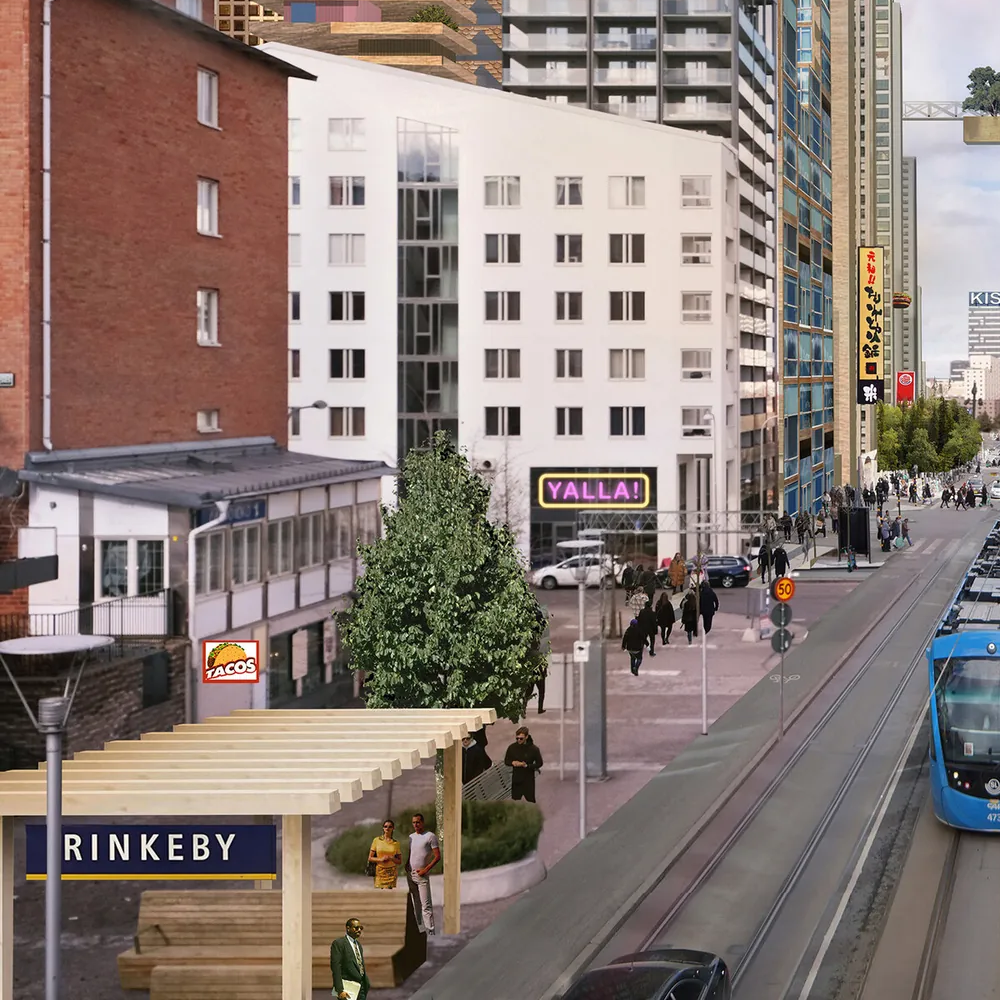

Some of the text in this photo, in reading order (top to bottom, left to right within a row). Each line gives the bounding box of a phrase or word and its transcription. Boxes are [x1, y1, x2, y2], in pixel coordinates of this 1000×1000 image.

[547, 481, 640, 500] YALLA!
[777, 583, 792, 596] 50
[205, 657, 257, 680] TACOS
[64, 833, 237, 861] RINKEBY
